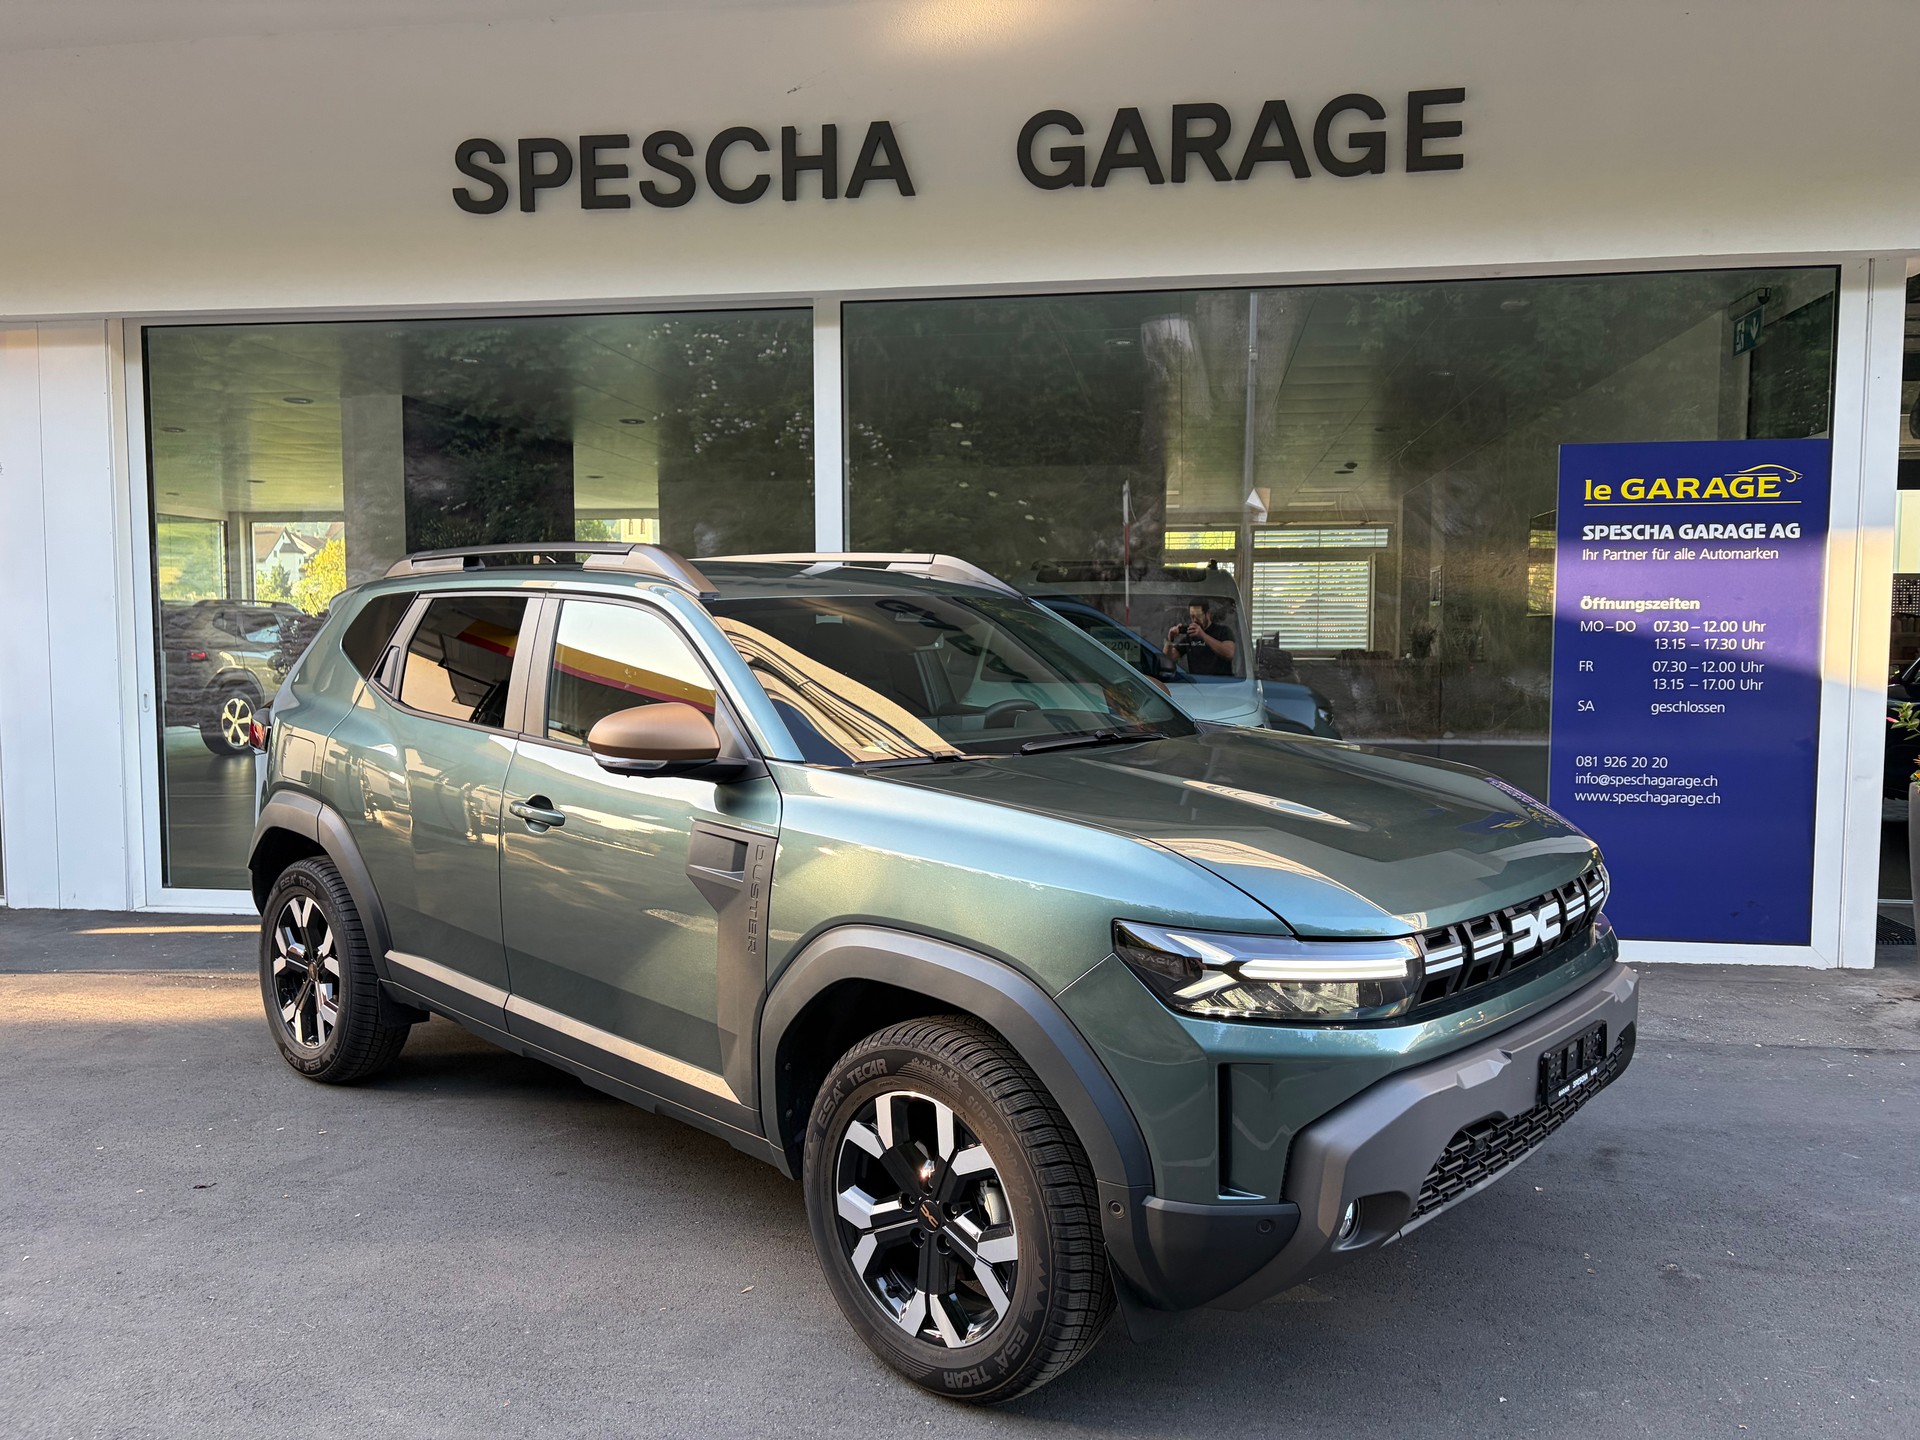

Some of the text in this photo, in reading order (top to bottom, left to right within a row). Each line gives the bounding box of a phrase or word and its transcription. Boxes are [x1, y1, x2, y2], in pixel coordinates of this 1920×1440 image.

[452, 87, 1466, 214] SPESCHA GARAGE
[1584, 476, 1782, 501] le GARAGE
[1582, 522, 1801, 541] SPESCHA GARAGE AG
[1582, 547, 1779, 561] Ihr Partner für alle Automarken
[1580, 596, 1700, 613] Öffnungszeiten
[1653, 620, 1689, 633] 07.30
[1703, 620, 1738, 633] 12.00
[1742, 620, 1766, 633] Uhr
[1655, 638, 1686, 650] 13.15
[1704, 638, 1738, 650] 17.30
[1741, 638, 1766, 650] Uhr
[1579, 660, 1594, 672] FR
[1652, 661, 1687, 673] 07.30
[1701, 661, 1736, 673] 12.00
[1740, 660, 1765, 673] Uhr
[1653, 678, 1684, 690] 13.15
[1702, 678, 1736, 690] 17.00
[1740, 678, 1764, 690] Uhr
[1577, 700, 1726, 715] SA geschlossen
[1575, 755, 1668, 769] 081 926 20 20
[1575, 772, 1718, 789] info@speschagarage.ch
[1574, 791, 1721, 806] www.speschagarage.ch
[747, 844, 766, 955] DUSTER
[846, 1058, 888, 1087] TECAR
[943, 1365, 992, 1389] TECAR
